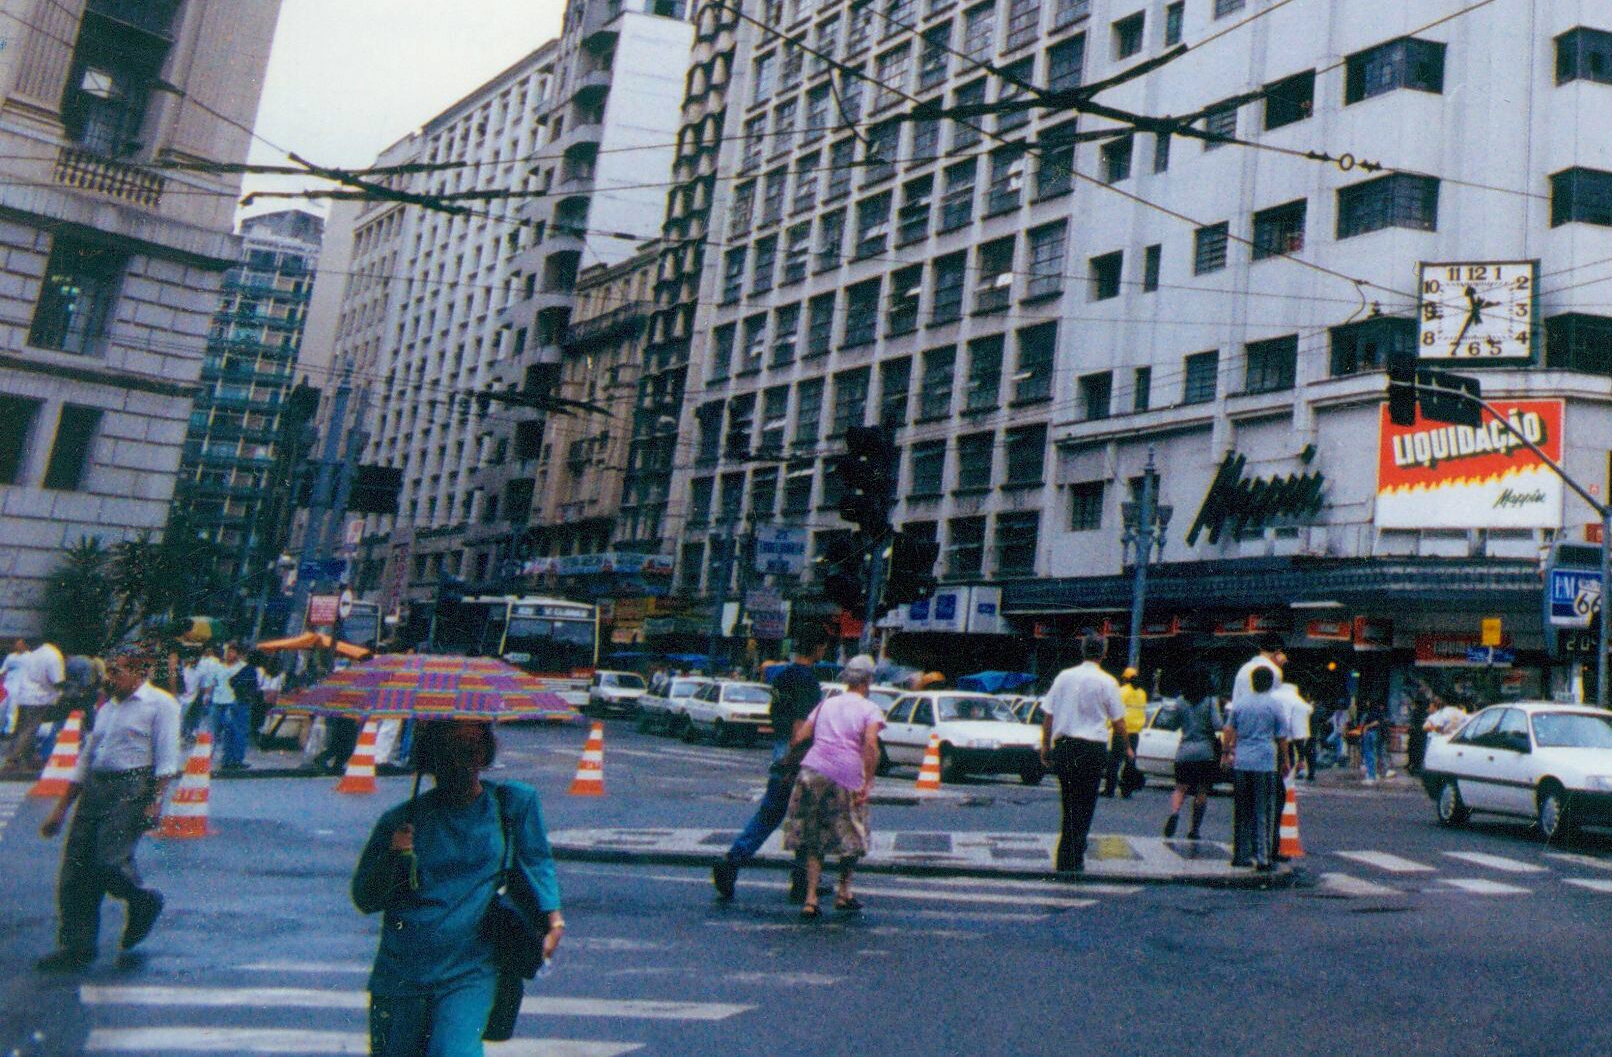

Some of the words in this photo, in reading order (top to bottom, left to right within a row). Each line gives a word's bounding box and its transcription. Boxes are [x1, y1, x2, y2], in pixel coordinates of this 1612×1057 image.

[1447, 267, 1461, 281] 11
[1467, 266, 1487, 281] 12
[1493, 267, 1502, 281] 1
[1422, 280, 1440, 294] 10
[1516, 275, 1529, 290] 2
[1515, 303, 1528, 317] 3
[1422, 331, 1435, 346] 8
[1514, 331, 1529, 345] 4
[1467, 342, 1481, 357] 6
[1392, 407, 1543, 467] LIQUIDAÇÃO
[1492, 489, 1546, 509] Mappin
